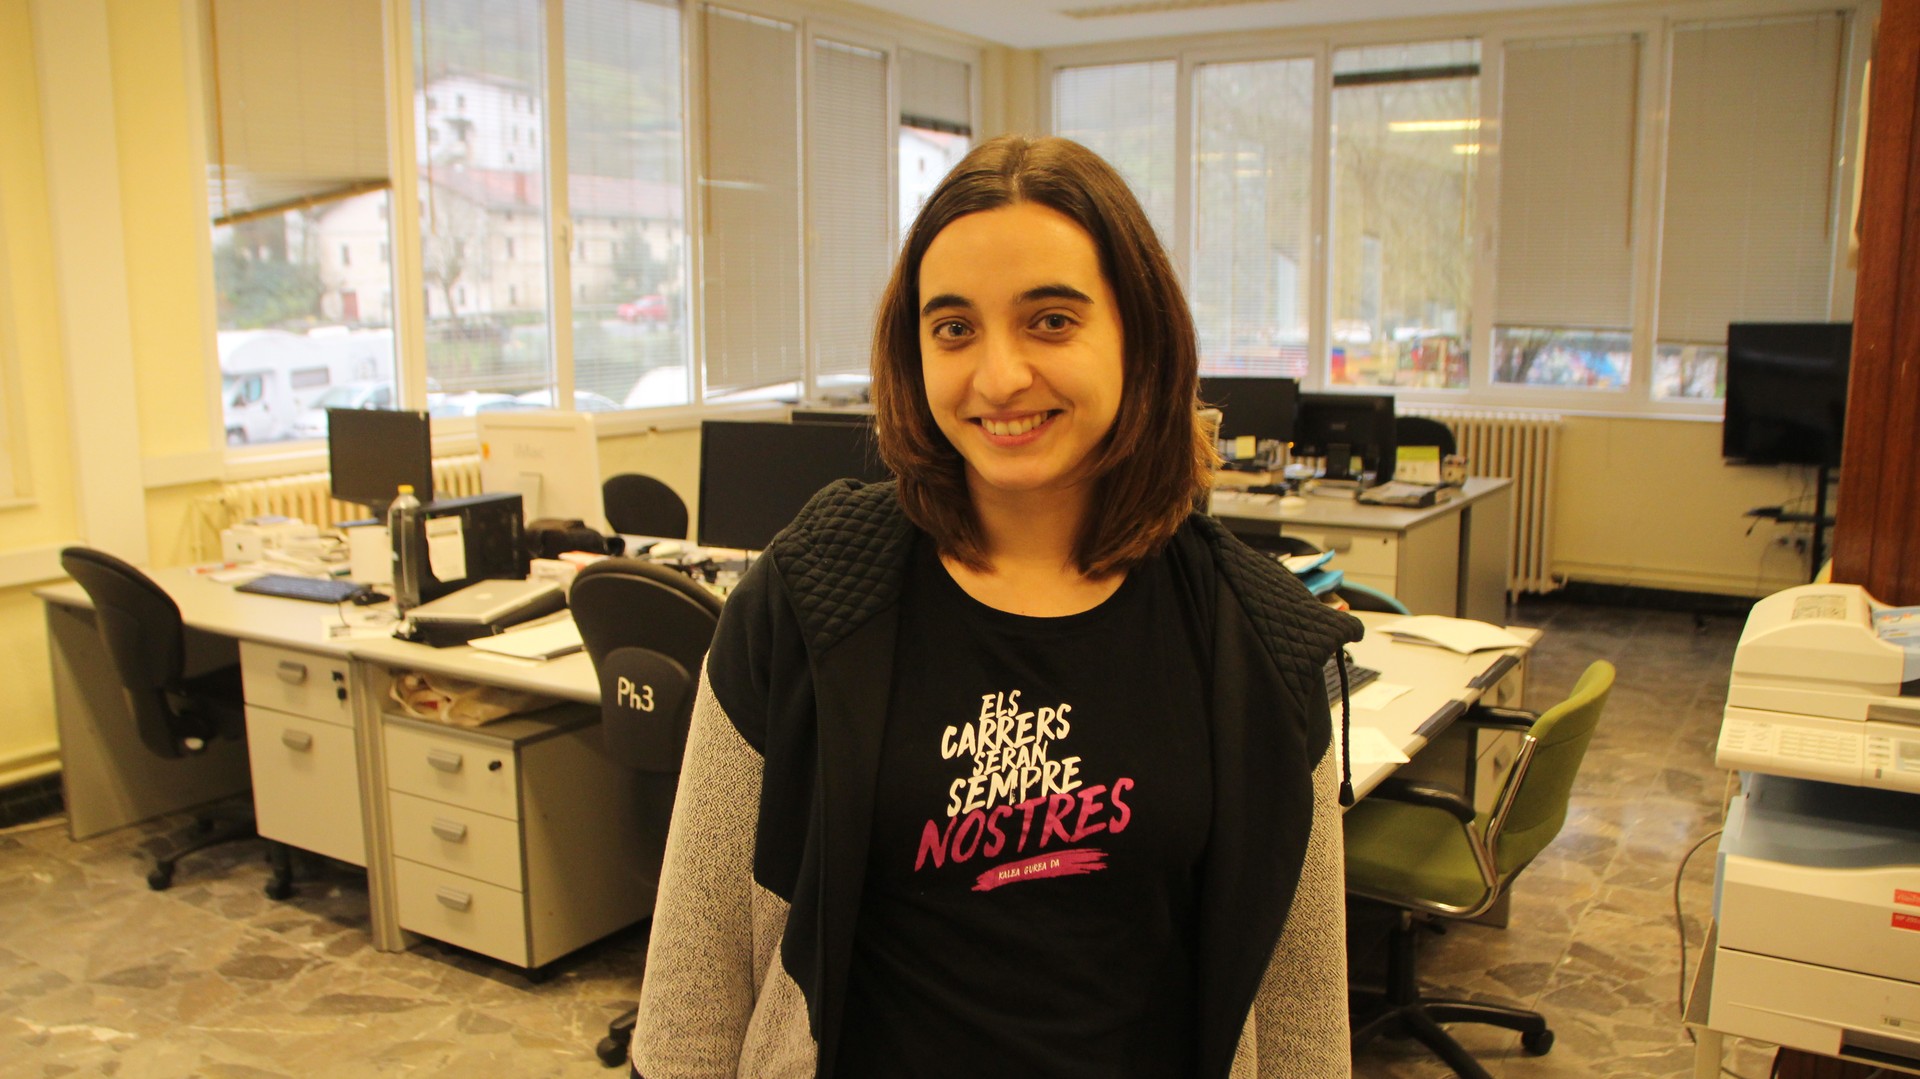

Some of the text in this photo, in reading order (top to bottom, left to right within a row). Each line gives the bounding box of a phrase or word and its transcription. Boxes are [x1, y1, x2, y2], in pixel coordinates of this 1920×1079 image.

[617, 676, 655, 712] Ph3
[980, 689, 1021, 720] ELS
[941, 703, 1072, 760] CARRERS
[972, 740, 1049, 777] SERAN
[947, 756, 1083, 817] SEMPRE
[914, 777, 1135, 872] NOSTRES
[998, 858, 1060, 880] KALEA GUREA DA
